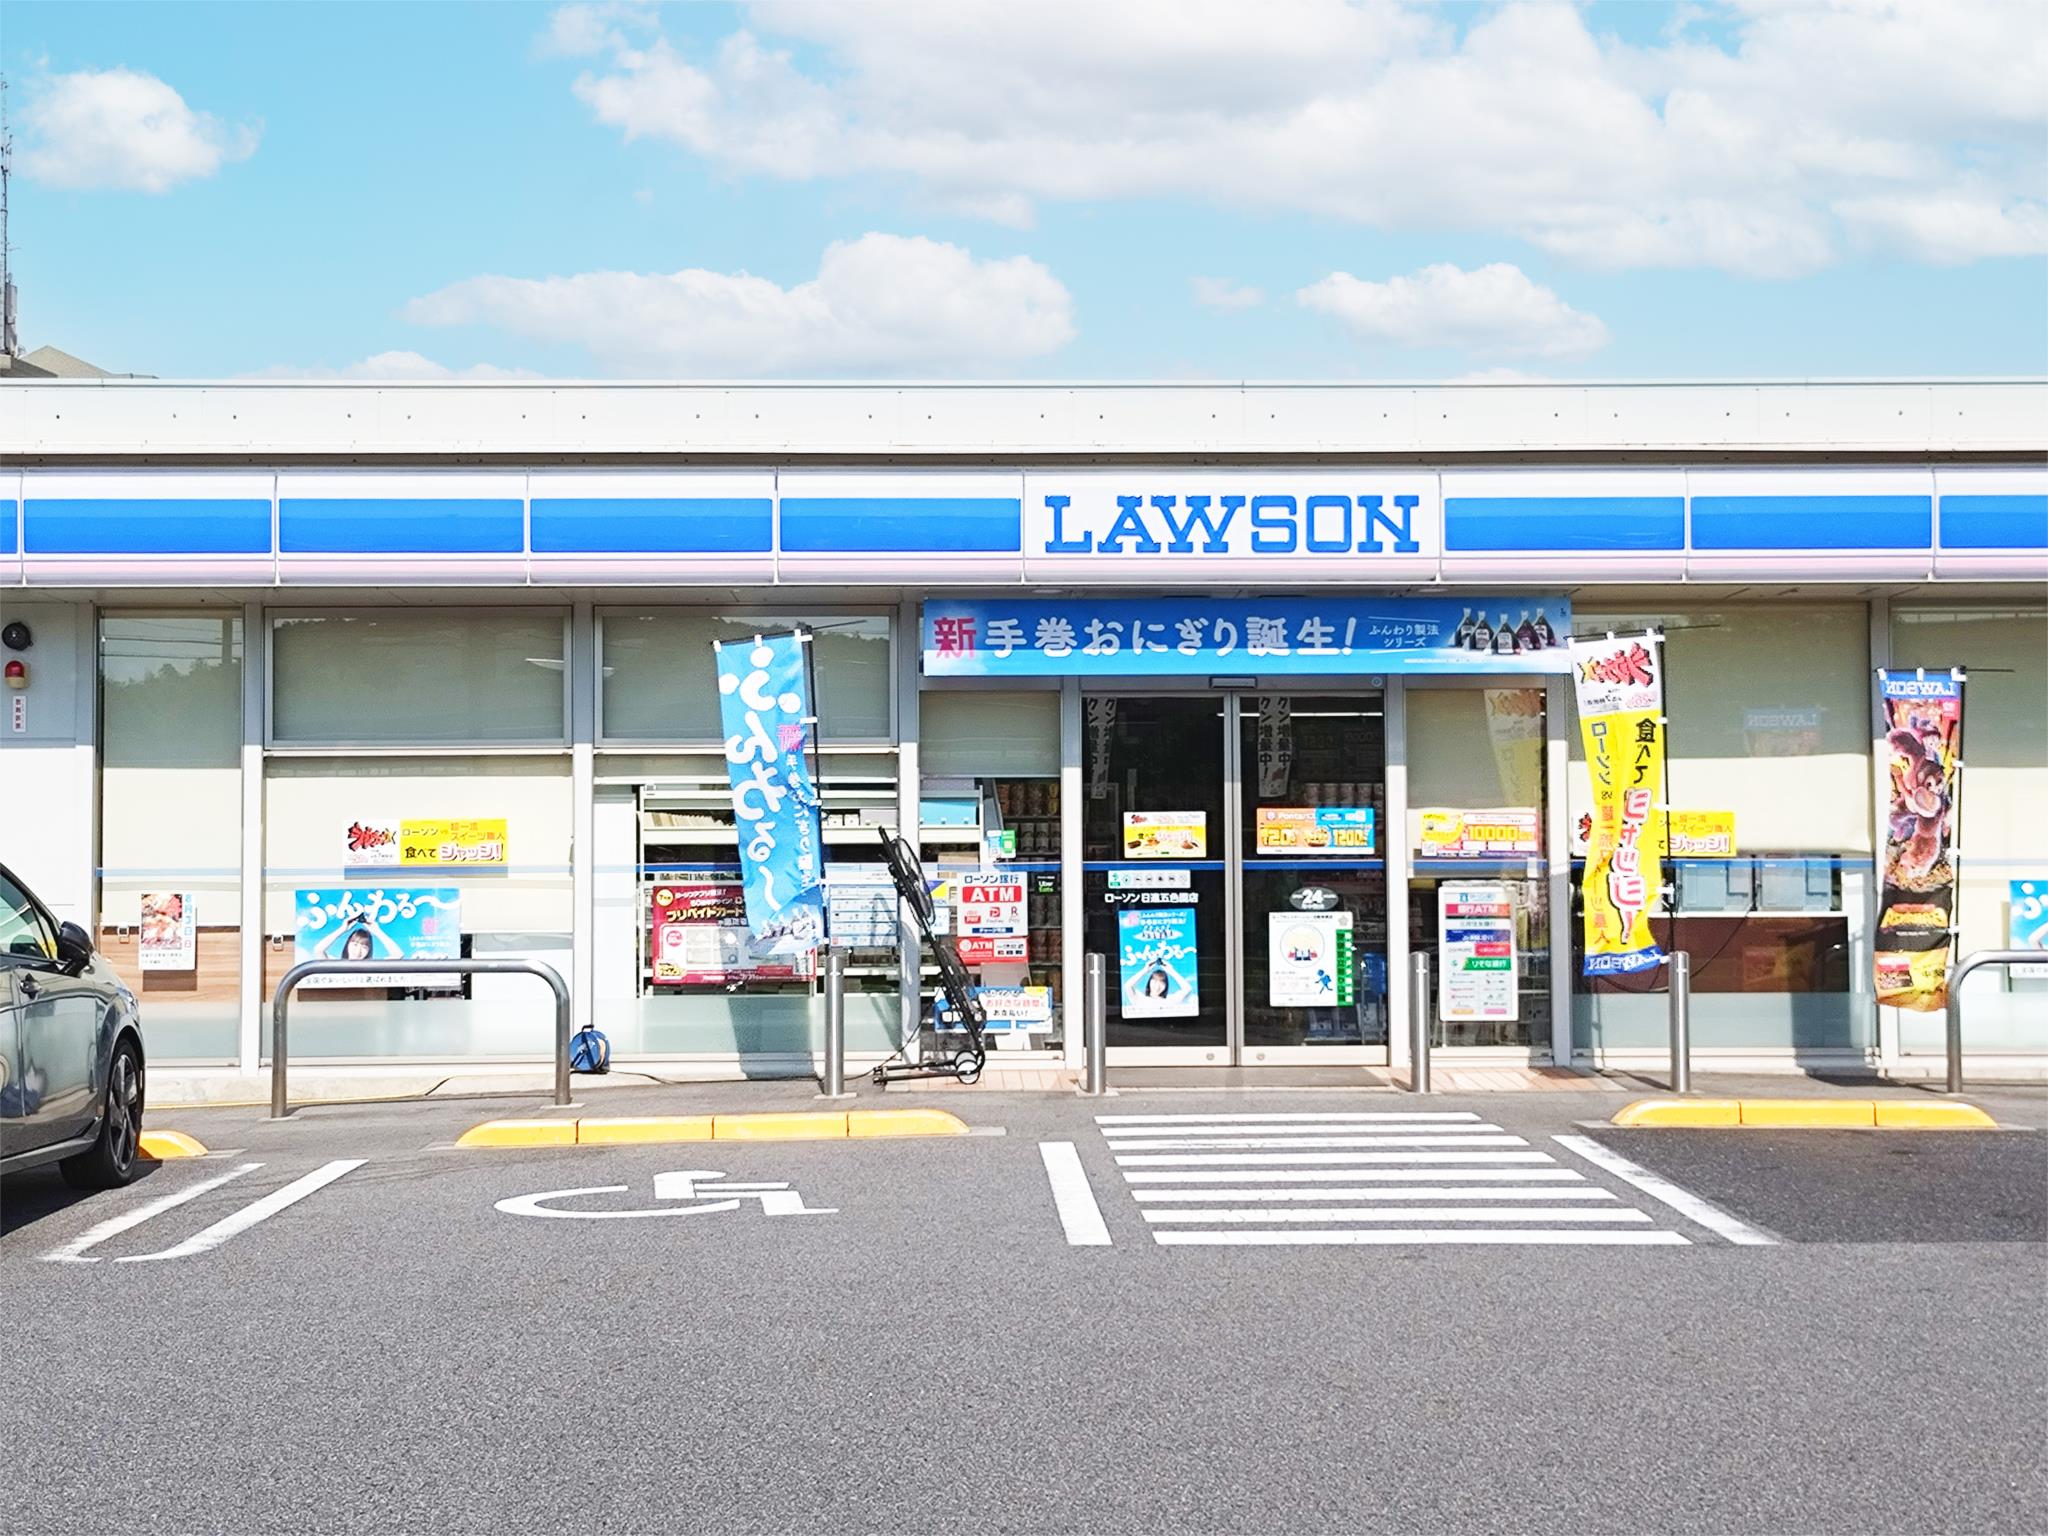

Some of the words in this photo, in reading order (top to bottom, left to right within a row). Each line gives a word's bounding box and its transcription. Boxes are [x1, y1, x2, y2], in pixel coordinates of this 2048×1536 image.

[1045, 495, 1419, 553] LAWSON
[1369, 623, 1439, 637] ふんわり製法
[1383, 637, 1426, 648] シリーズ
[964, 875, 1020, 884] ローソン銀行
[970, 886, 1015, 903] ATM
[1301, 889, 1324, 904] 24
[971, 941, 993, 950] ATM
